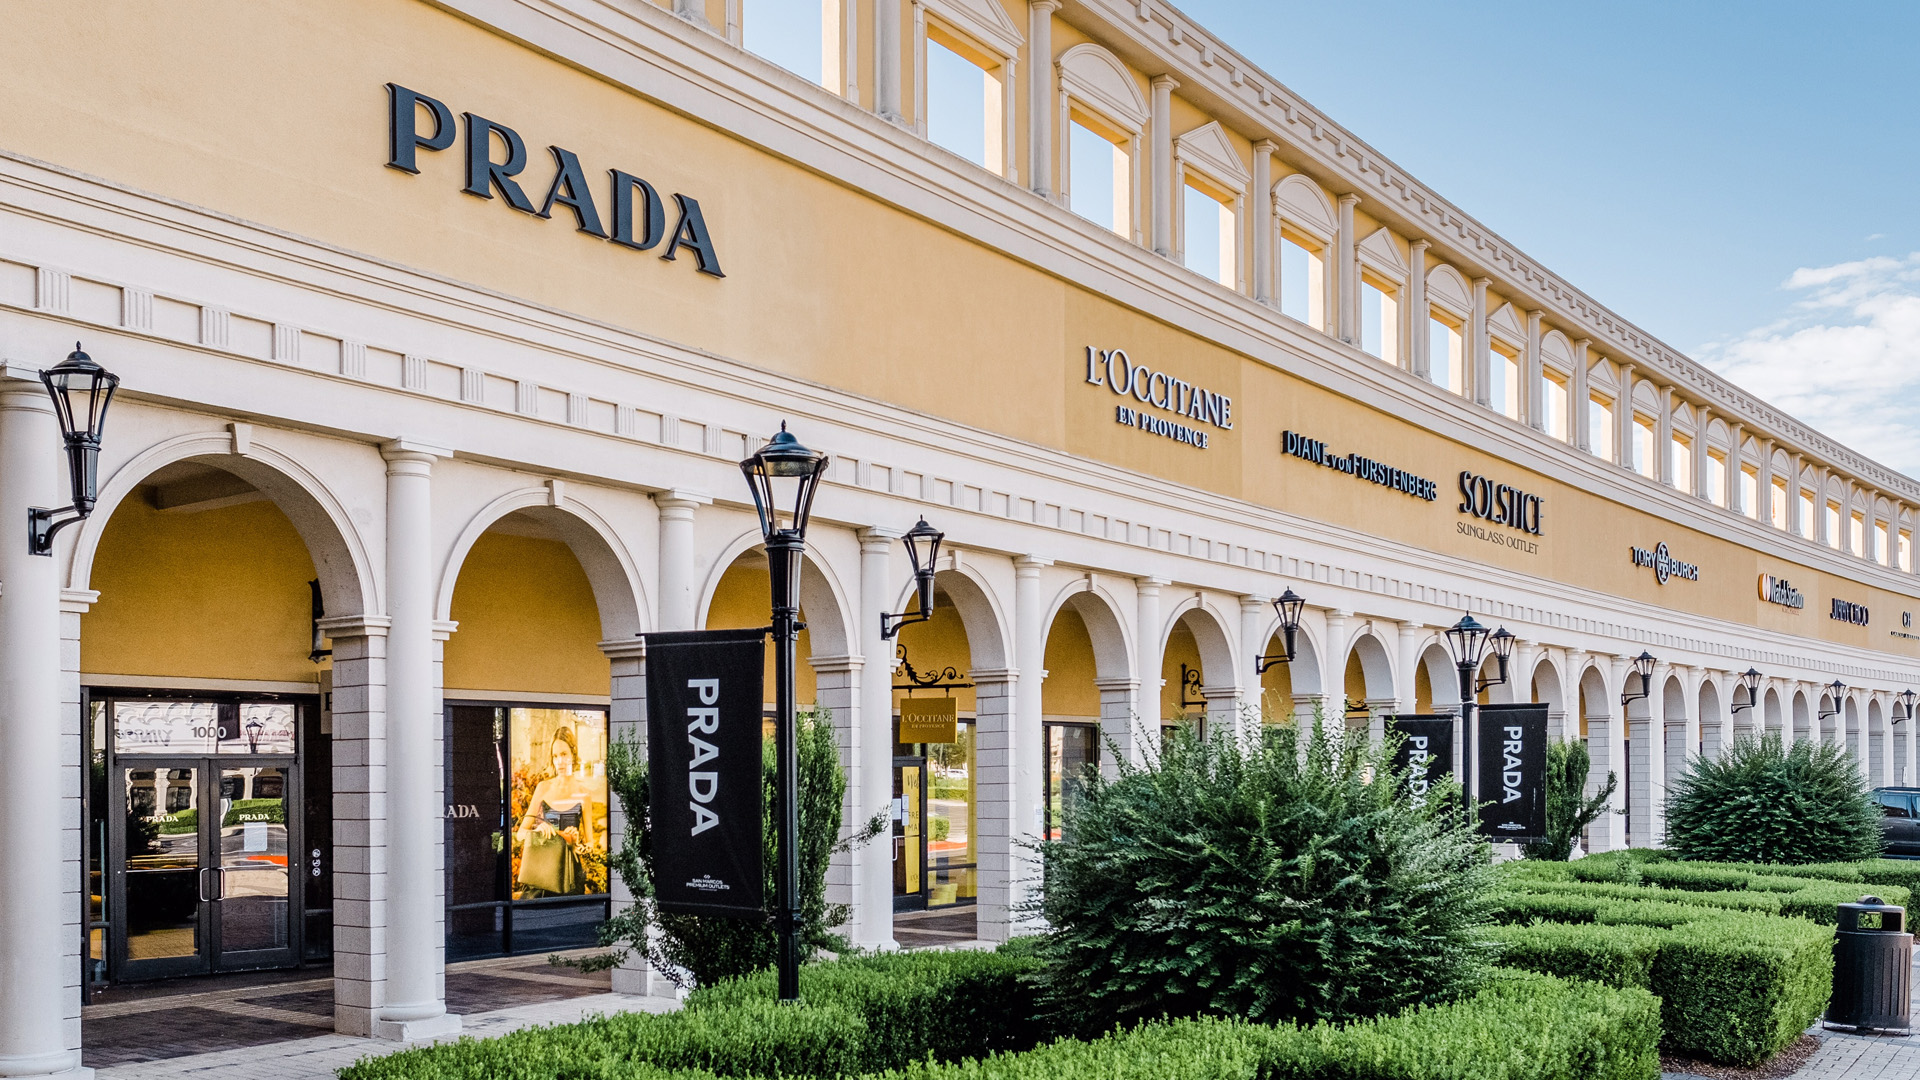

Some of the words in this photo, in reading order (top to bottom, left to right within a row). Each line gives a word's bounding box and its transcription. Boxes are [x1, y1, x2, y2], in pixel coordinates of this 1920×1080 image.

[384, 82, 727, 279] PRADA
[1085, 345, 1234, 430] L'OCCITANE
[1116, 405, 1137, 427] EN
[1138, 412, 1209, 449] PROVENCE
[1281, 430, 1331, 466] DIANE
[1349, 453, 1438, 501] FURSTENBERG
[1458, 471, 1545, 536] SOLSTICE
[1456, 521, 1505, 546] SUNGLASS
[1506, 536, 1539, 555] OUTLET
[1630, 546, 1657, 569] TORY
[1669, 558, 1699, 581] BURCH
[1768, 575, 1787, 606] Watch
[191, 726, 227, 739] 1000
[687, 678, 719, 837] PRADA
[1502, 726, 1523, 804] PRADA
[146, 815, 179, 823] PRADA
[239, 813, 270, 821] PRADA
[444, 804, 480, 818] ADA
